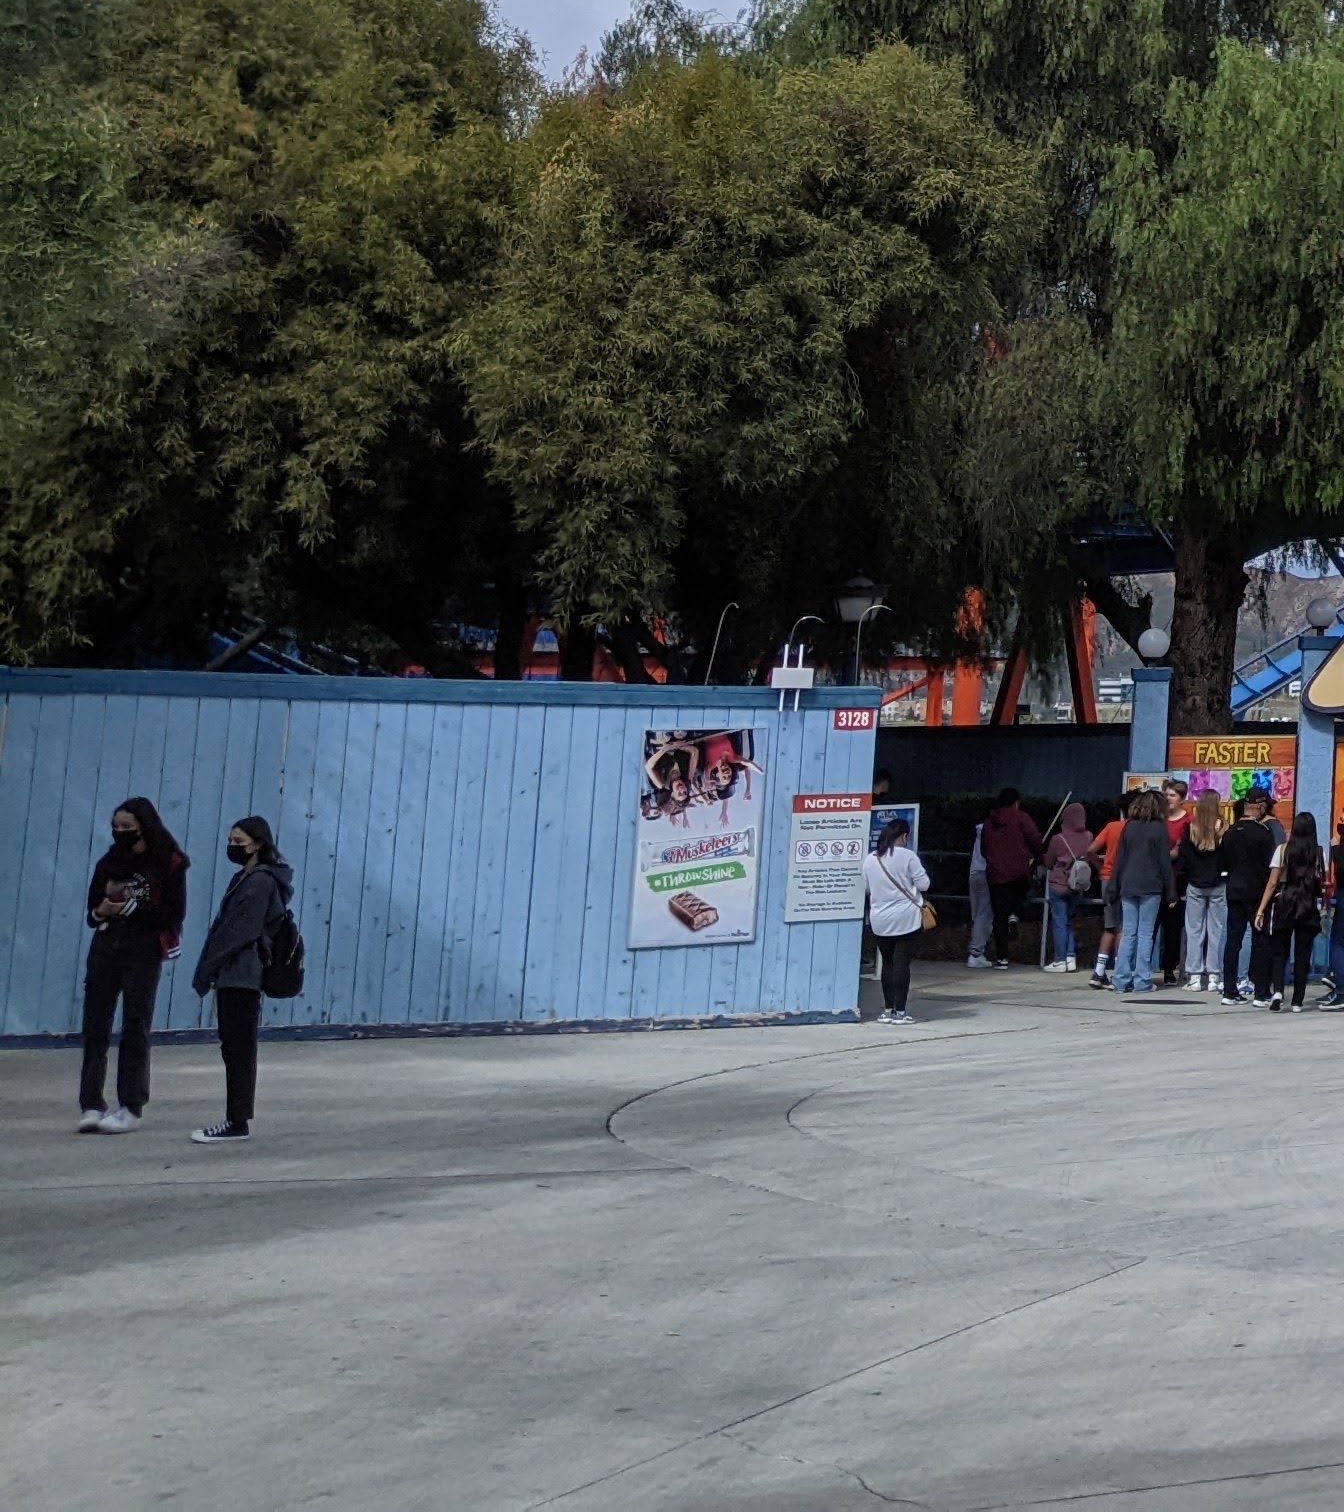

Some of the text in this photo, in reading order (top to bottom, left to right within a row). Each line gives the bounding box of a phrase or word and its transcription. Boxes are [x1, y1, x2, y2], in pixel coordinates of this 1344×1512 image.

[838, 711, 870, 726] 3128
[1194, 742, 1271, 765] FASTER
[804, 798, 861, 809] NOTICE
[674, 832, 741, 863] Musketeers
